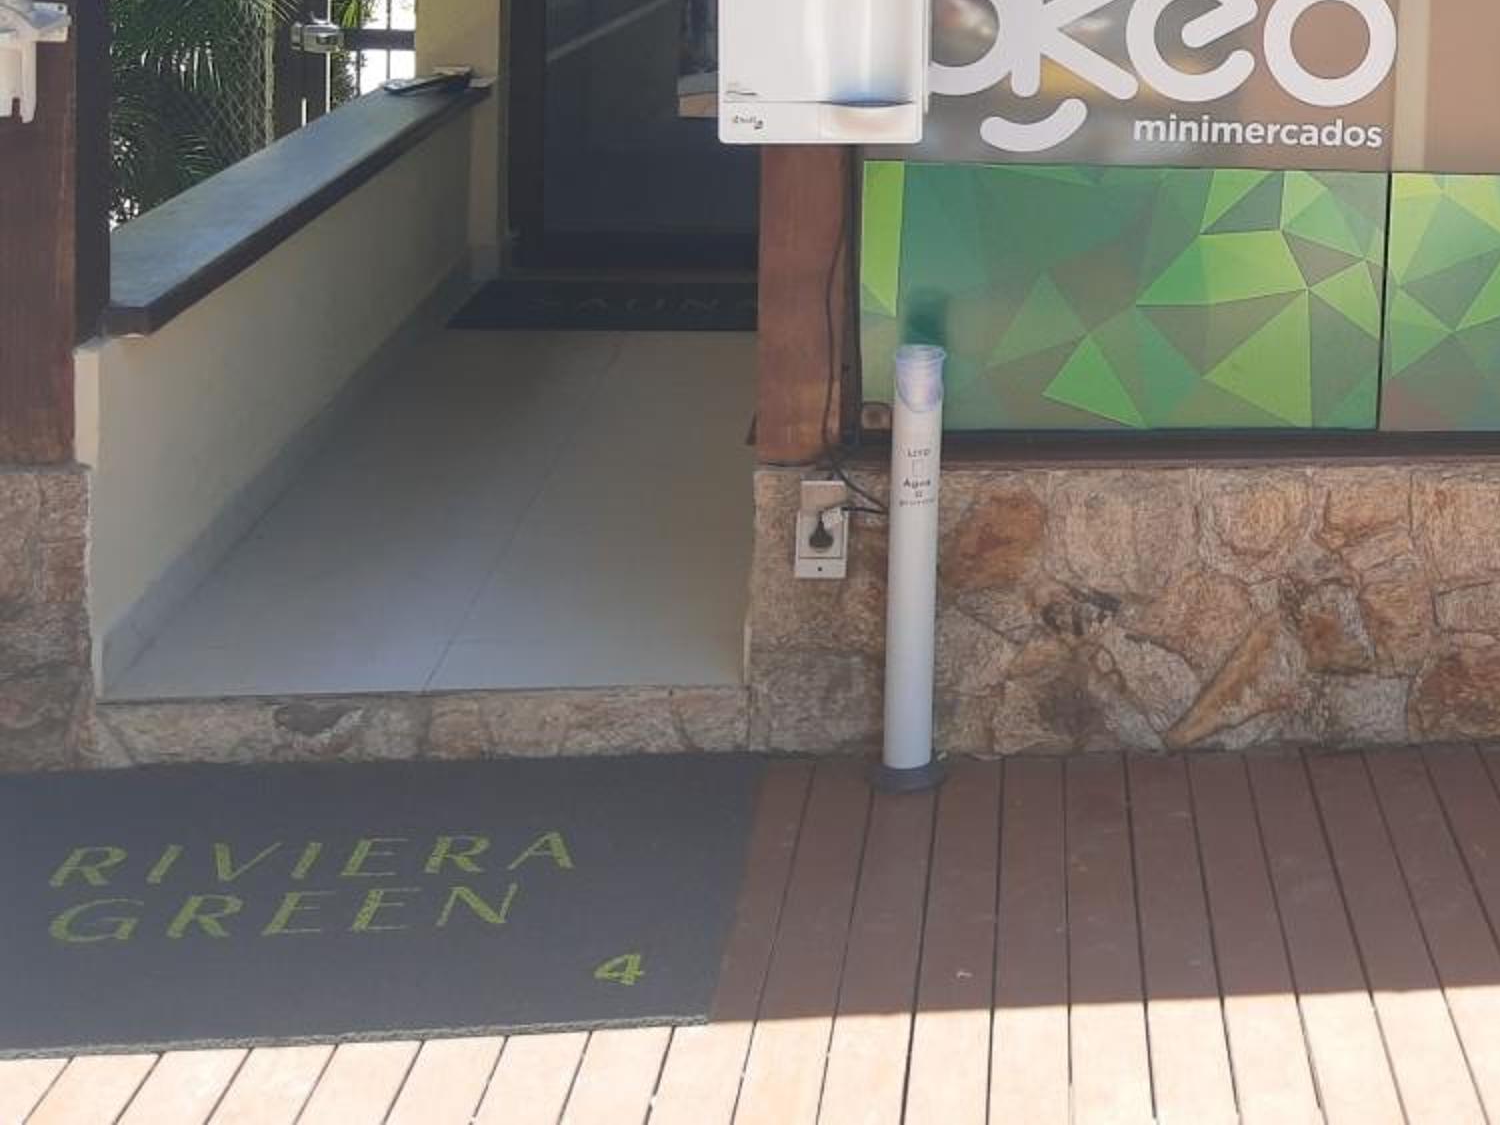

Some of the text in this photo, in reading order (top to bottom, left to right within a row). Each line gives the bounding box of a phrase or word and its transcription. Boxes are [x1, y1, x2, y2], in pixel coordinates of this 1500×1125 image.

[1132, 115, 1383, 148] minimercados
[48, 830, 576, 887] RIVIERA
[48, 883, 520, 944] GREEN
[592, 953, 646, 986] 4
